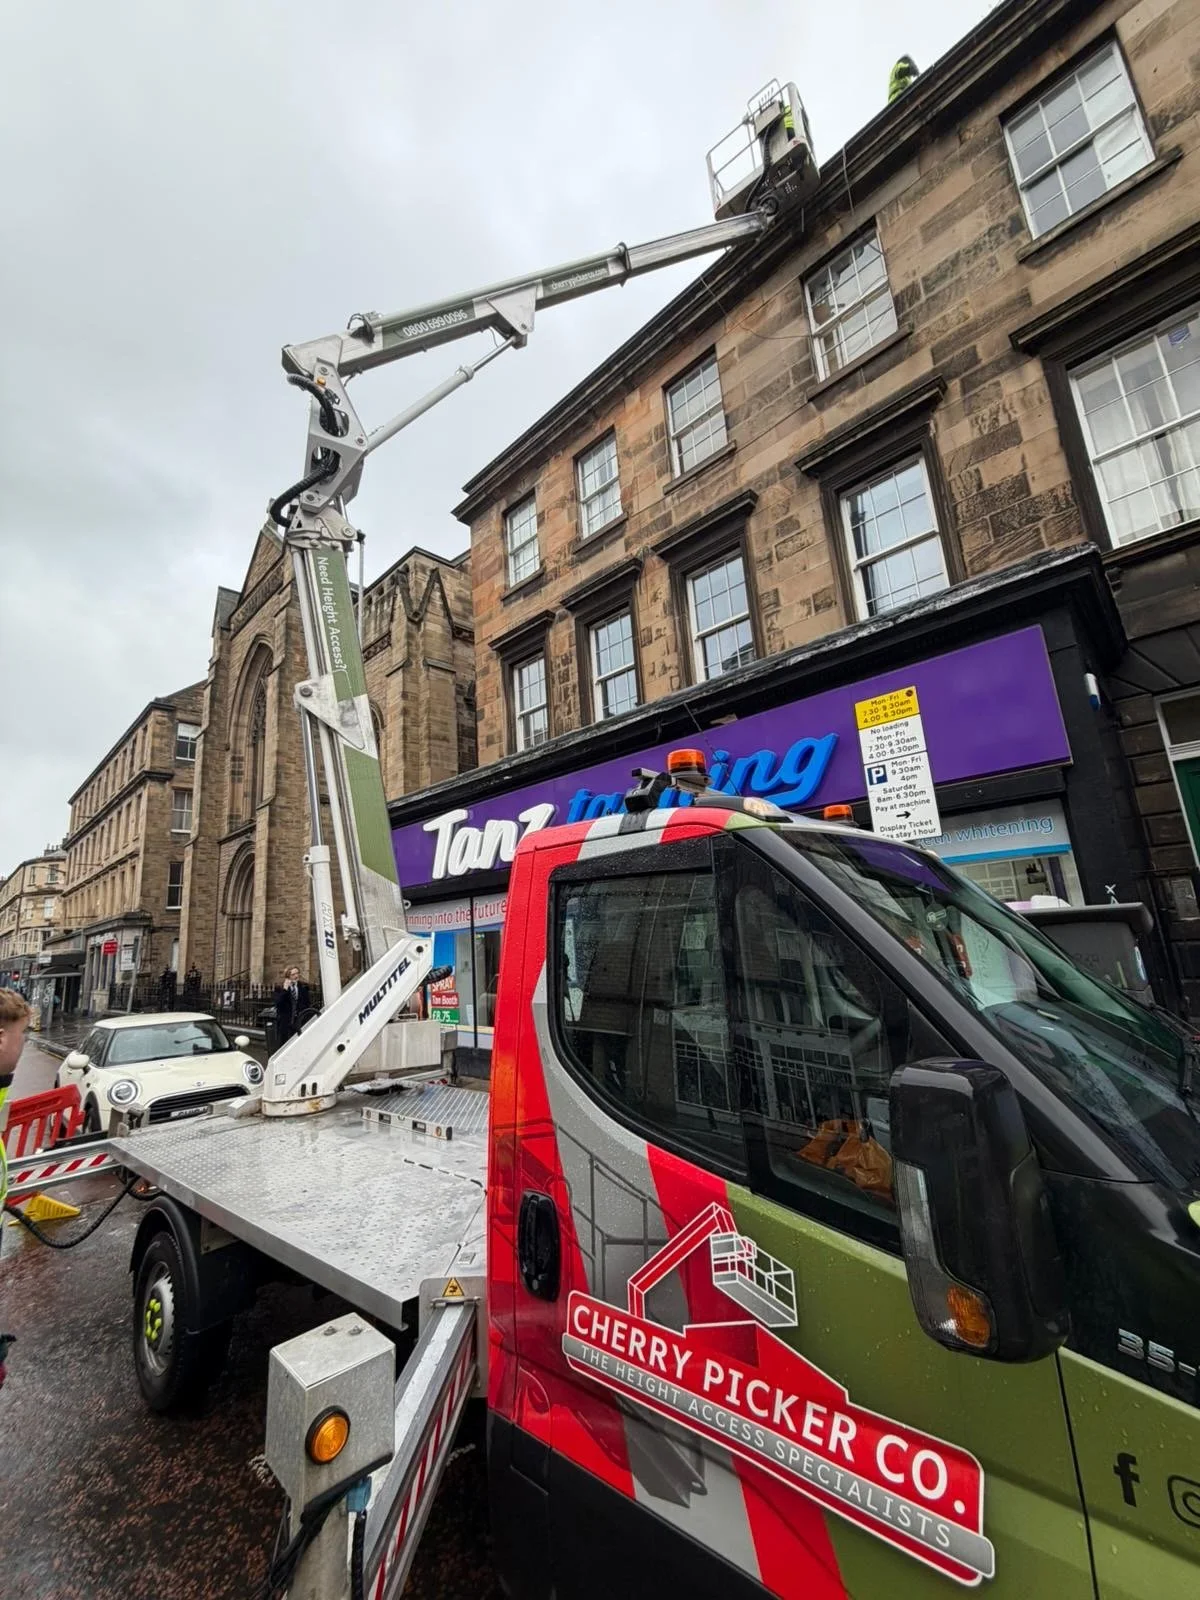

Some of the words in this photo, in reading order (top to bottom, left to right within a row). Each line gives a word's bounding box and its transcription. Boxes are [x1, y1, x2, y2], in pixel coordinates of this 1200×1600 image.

[402, 321, 429, 337] 0800
[427, 315, 446, 329] 699
[443, 309, 468, 325] 0096
[317, 556, 333, 586] Need
[322, 587, 338, 625] Height
[329, 626, 347, 669] Access?
[882, 721, 909, 732] loading
[871, 766, 885, 784] P
[900, 774, 917, 782] 4pm
[883, 783, 917, 794] Saturday
[898, 798, 931, 809] machine
[880, 823, 907, 833] Display
[909, 819, 933, 828] Ticket
[918, 827, 936, 835] hour
[956, 816, 1054, 842] whitening
[435, 912, 453, 924] into
[455, 906, 471, 922] the
[474, 899, 507, 919] future
[358, 956, 411, 1026] MULTITEL
[432, 995, 441, 1005] Tan
[442, 994, 458, 1005] Booth
[1118, 1328, 1200, 1377] 35-
[573, 1305, 693, 1380] CHERRY
[702, 1358, 857, 1463] PICKER
[876, 1433, 966, 1516] CO.
[581, 1344, 609, 1370] THE
[616, 1362, 681, 1405] HEIGHT
[688, 1395, 765, 1448] ACCESS
[774, 1434, 951, 1549] SPECIALISTS
